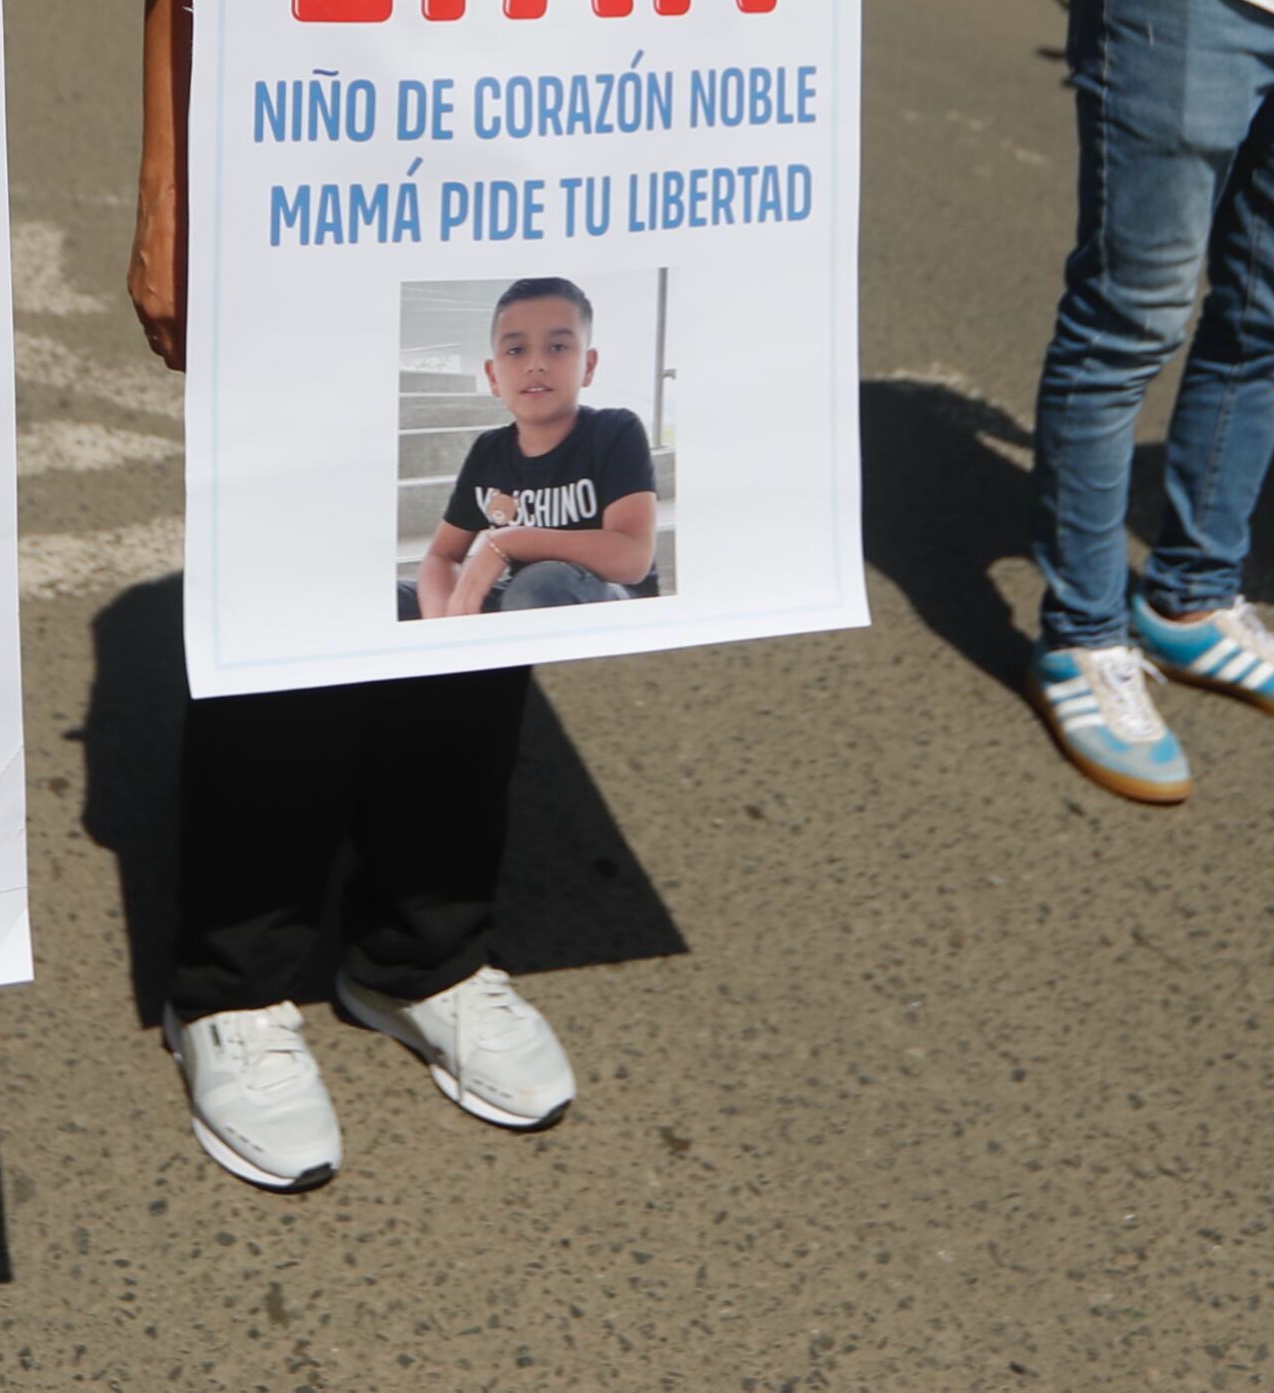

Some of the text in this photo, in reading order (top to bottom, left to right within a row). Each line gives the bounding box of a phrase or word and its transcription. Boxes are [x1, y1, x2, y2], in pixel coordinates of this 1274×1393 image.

[255, 50, 815, 142] NIÑO DE CORAZÓN NOBLE
[271, 159, 811, 246] MAMÁ PIDE TU LIBERTAD
[475, 478, 597, 527] SCHINO
